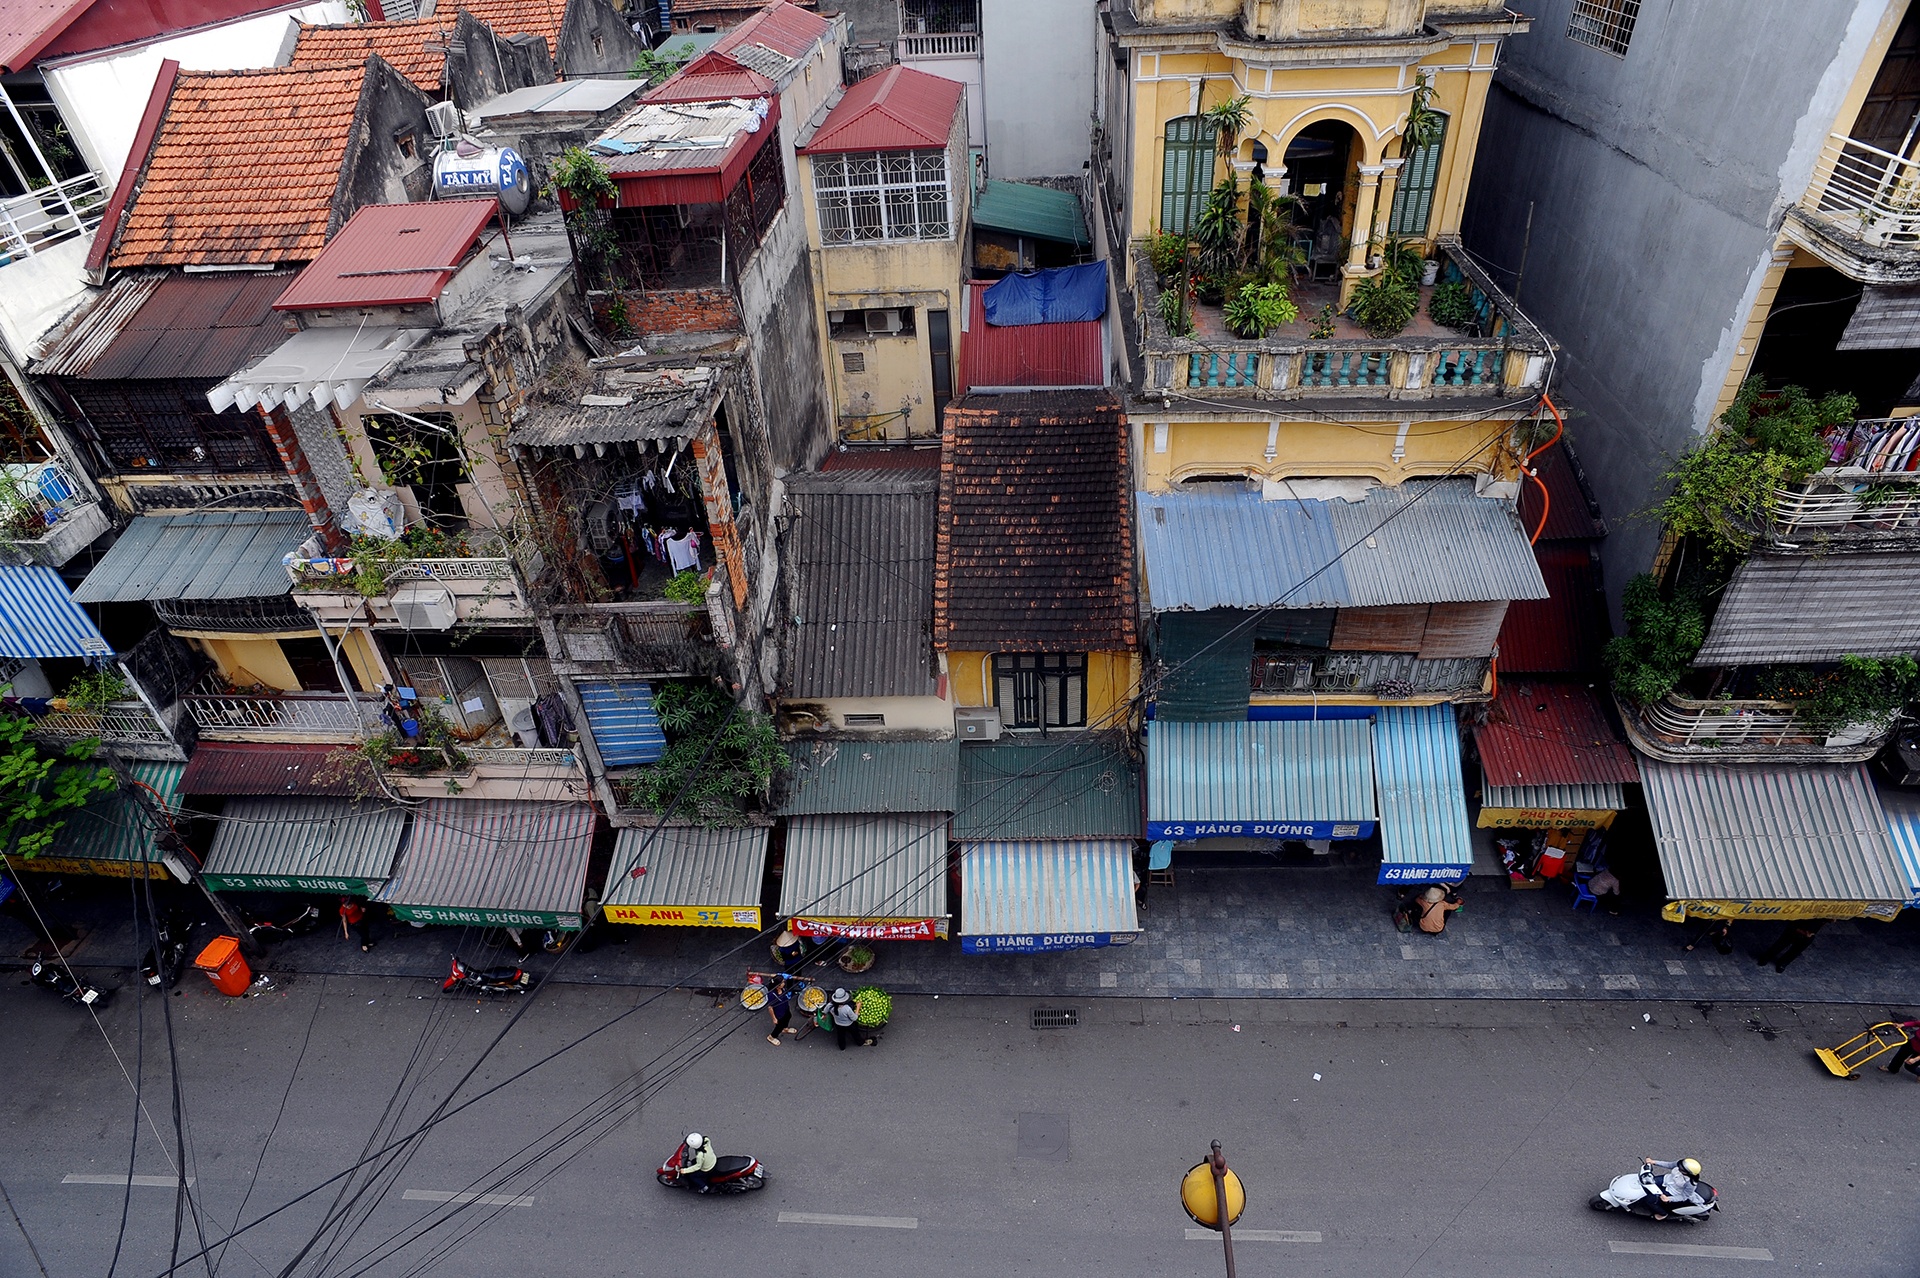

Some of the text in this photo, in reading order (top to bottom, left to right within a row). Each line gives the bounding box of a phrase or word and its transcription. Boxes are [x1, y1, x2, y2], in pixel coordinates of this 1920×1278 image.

[444, 170, 491, 185] TÂN MỸ
[1163, 823, 1314, 836] 63 HÀNG ĐƯỜNG
[1385, 867, 1462, 879] 63 HÀNG ĐƯỜNG
[223, 877, 349, 891] 53 HÀNG ĐƯỜNG
[411, 909, 433, 920] 55
[486, 912, 543, 925] ĐƯỜNG
[650, 910, 684, 920] ANH
[697, 911, 720, 921] 57
[975, 933, 1095, 947] 61 HÀNG ĐƯỜNG
